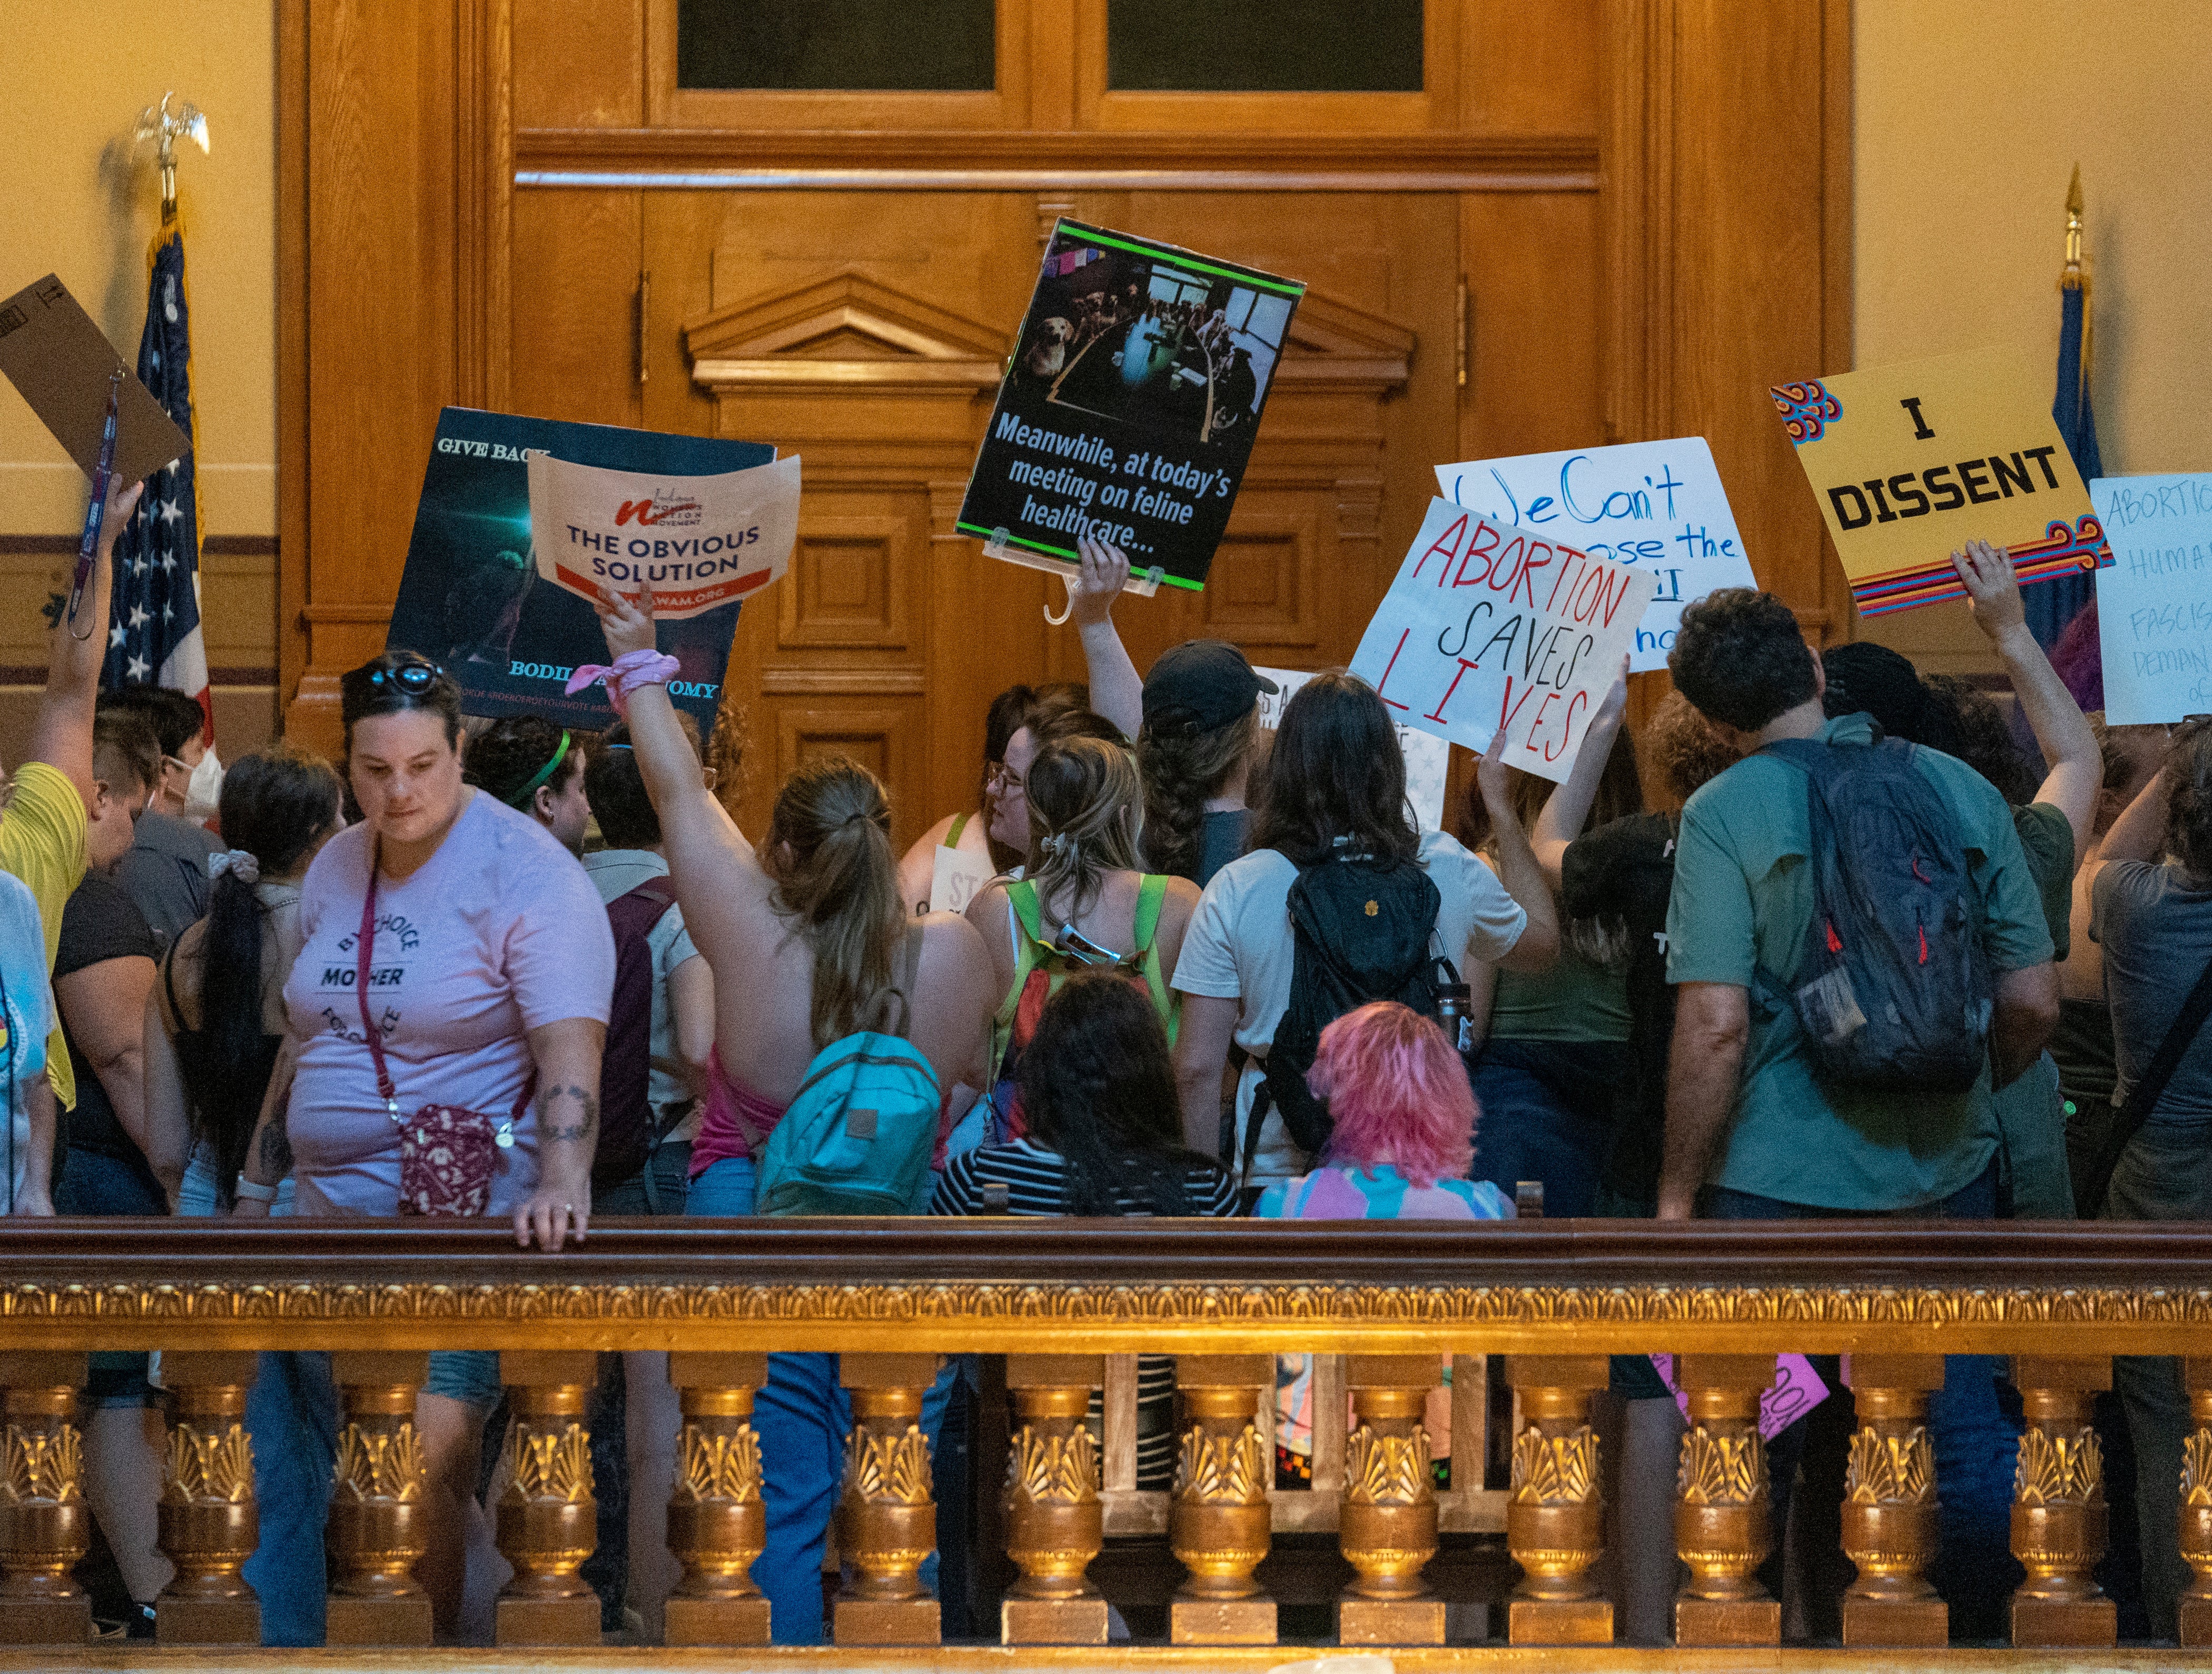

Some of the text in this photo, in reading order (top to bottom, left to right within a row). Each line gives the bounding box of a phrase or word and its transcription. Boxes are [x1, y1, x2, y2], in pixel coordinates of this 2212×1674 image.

[1900, 397, 1935, 440] I
[438, 438, 489, 458] GIVE
[994, 412, 1232, 498] Meanwhile, at today's
[1008, 459, 1194, 525] meeting on feline
[1560, 456, 1684, 524] Can't
[1827, 445, 2060, 531] DISSENT
[567, 524, 760, 558] THE OBVIOUS
[1021, 495, 1154, 553] healthcare...
[1675, 522, 1740, 559] the
[592, 554, 738, 582] SOLUTION
[1413, 513, 1631, 628] ABORTION
[2129, 543, 2212, 579] HUMA
[1438, 601, 1593, 690] SAVES
[1376, 627, 1587, 762] LIVES
[321, 968, 404, 986] MOHER
